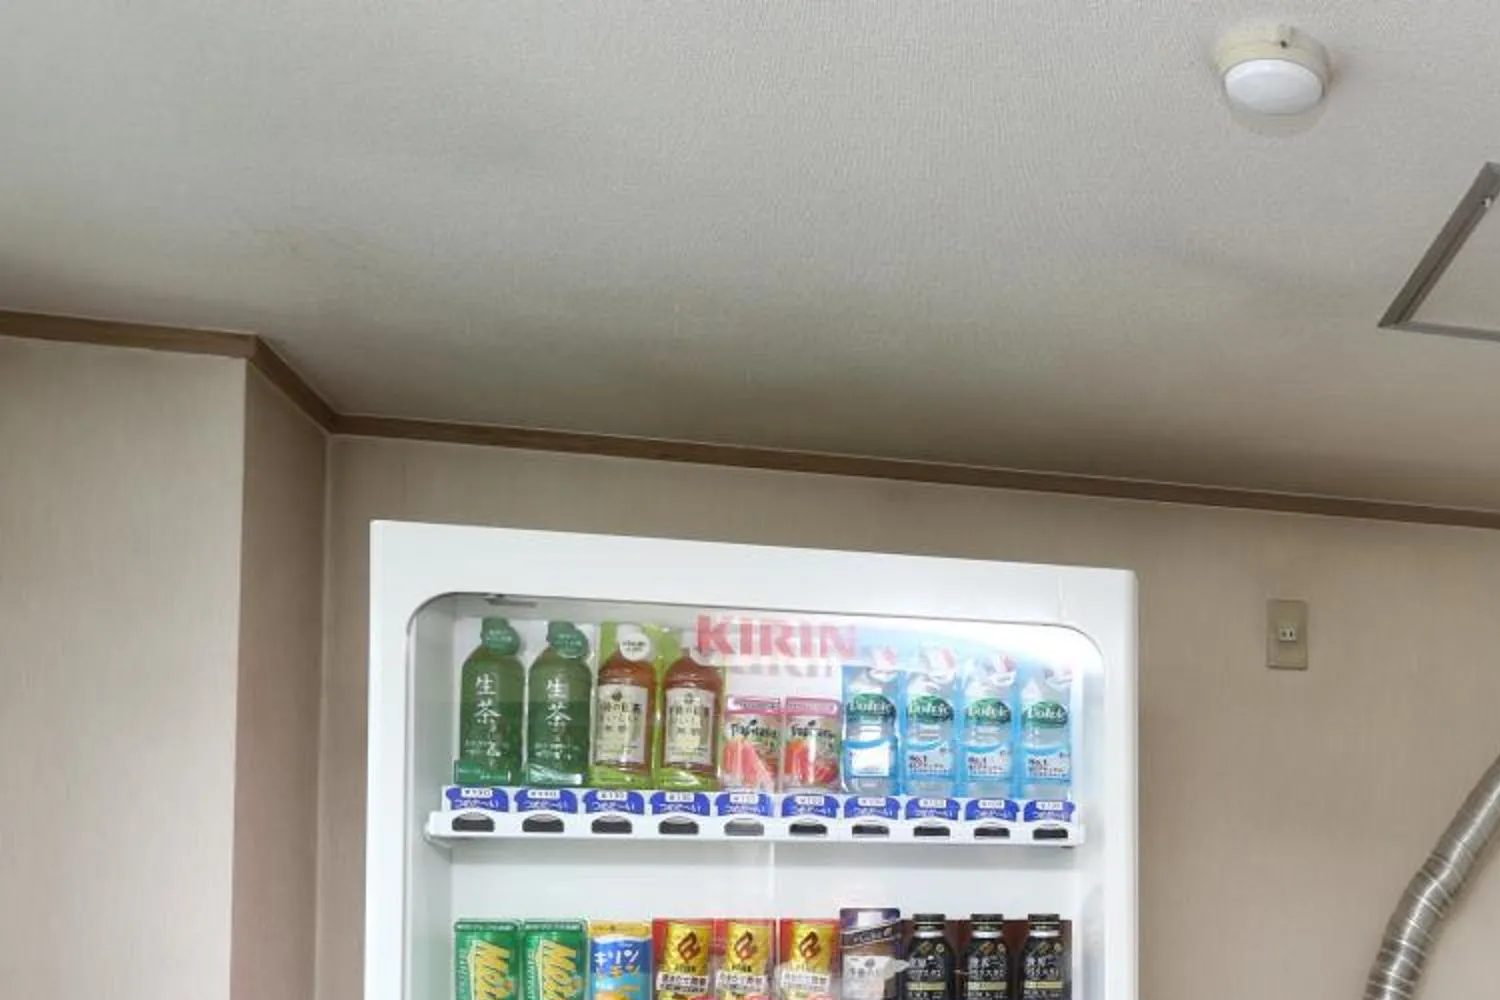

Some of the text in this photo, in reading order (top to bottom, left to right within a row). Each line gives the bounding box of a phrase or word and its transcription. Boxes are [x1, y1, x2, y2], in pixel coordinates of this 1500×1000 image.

[695, 614, 855, 657] KIRIN
[475, 672, 502, 725] 生茶
[546, 678, 572, 726] 生茶
